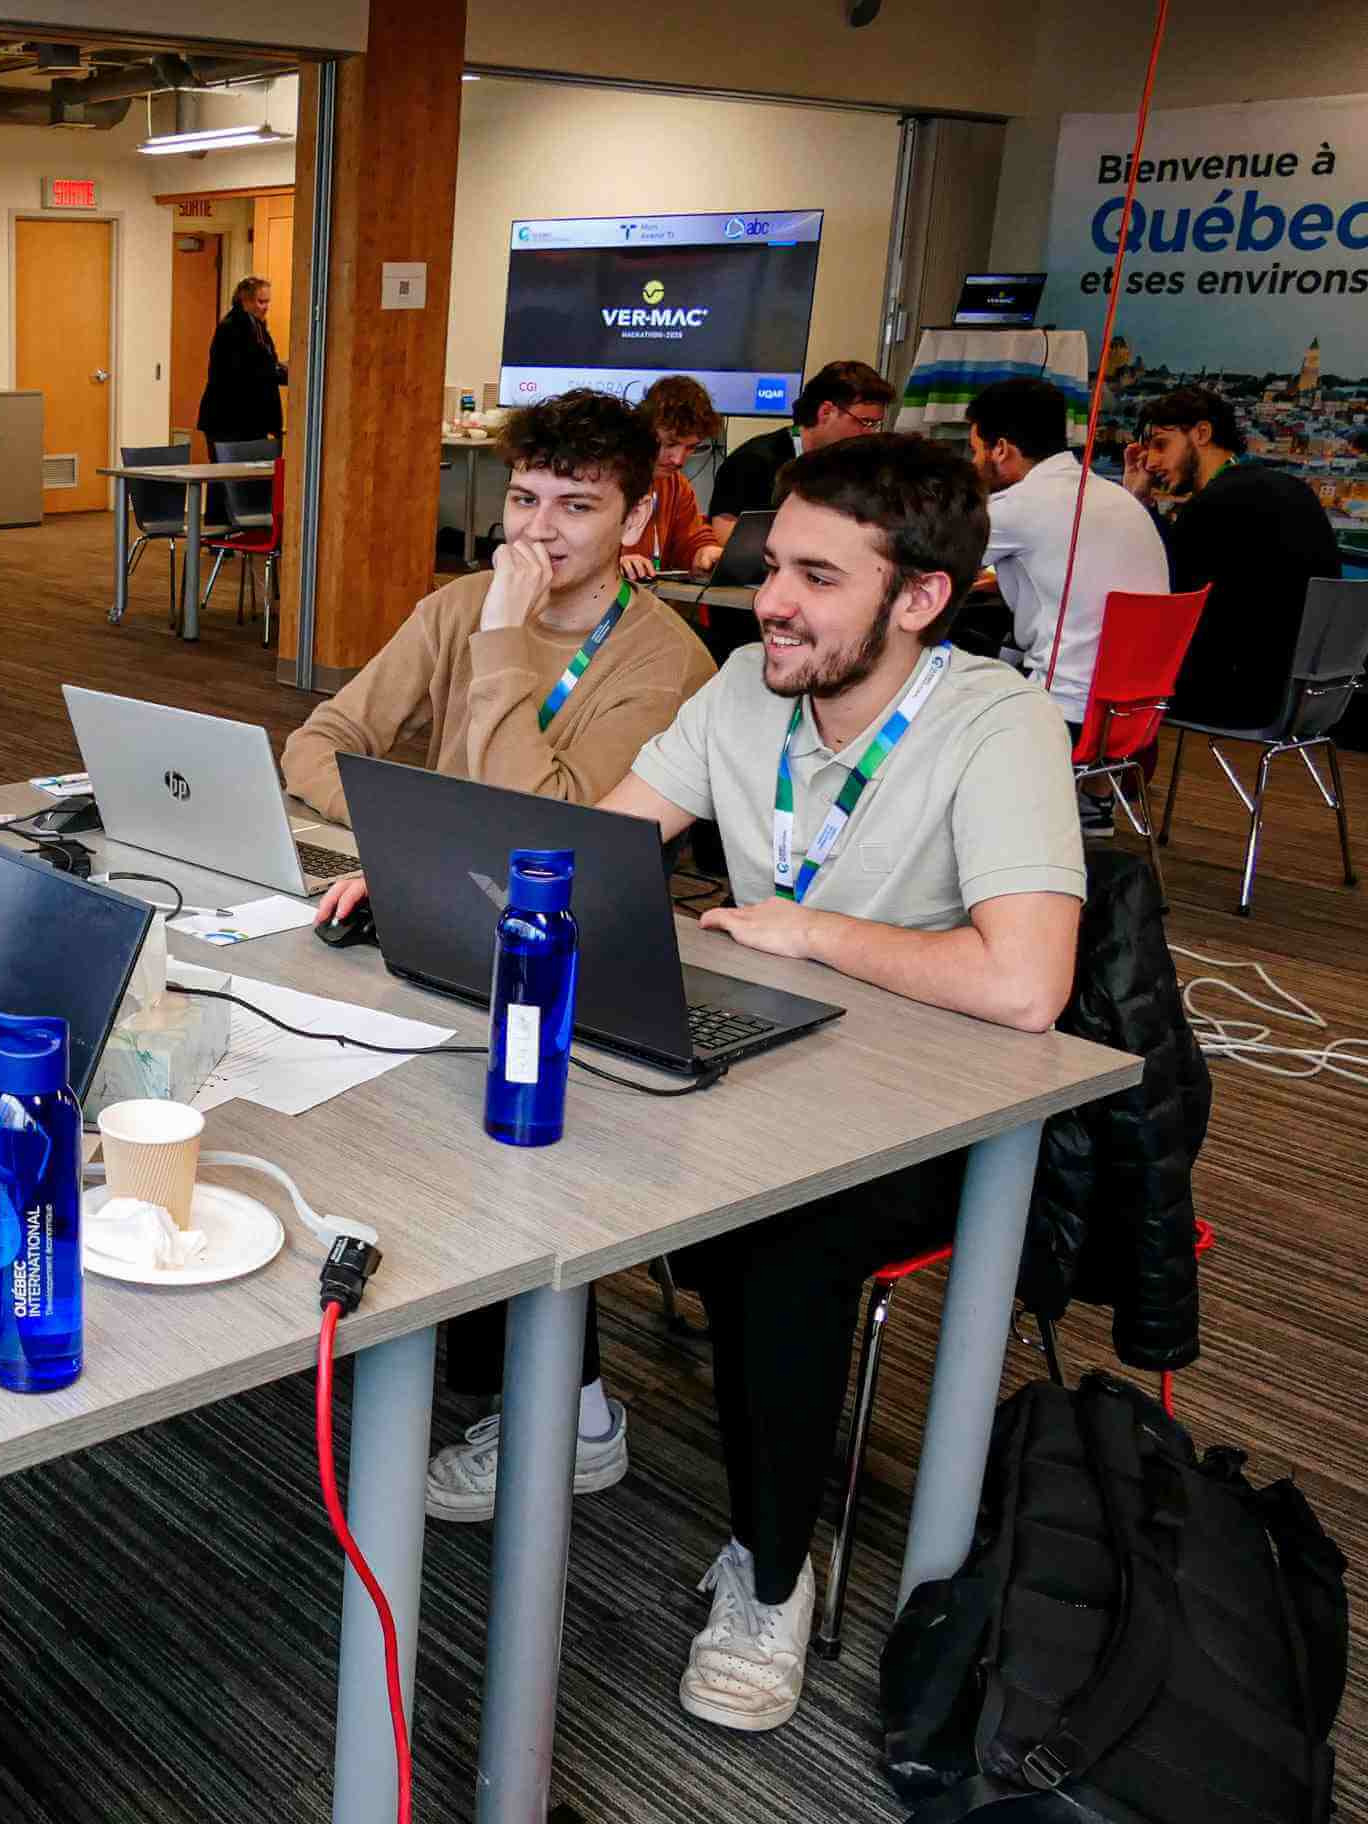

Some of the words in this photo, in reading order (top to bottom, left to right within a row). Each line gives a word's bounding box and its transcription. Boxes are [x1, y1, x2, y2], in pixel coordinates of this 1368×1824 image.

[1098, 150, 1298, 185] Bienvenue
[1312, 142, 1336, 175] à
[746, 217, 769, 235] abc
[1091, 189, 1368, 254] Québec
[1081, 268, 1115, 294] et
[1126, 273, 1184, 295] ses
[1197, 262, 1368, 295] environs
[519, 381, 537, 392] CGI
[27, 1204, 41, 1318] INTERNATIONAL
[12, 1259, 27, 1318] QUÉBEC
